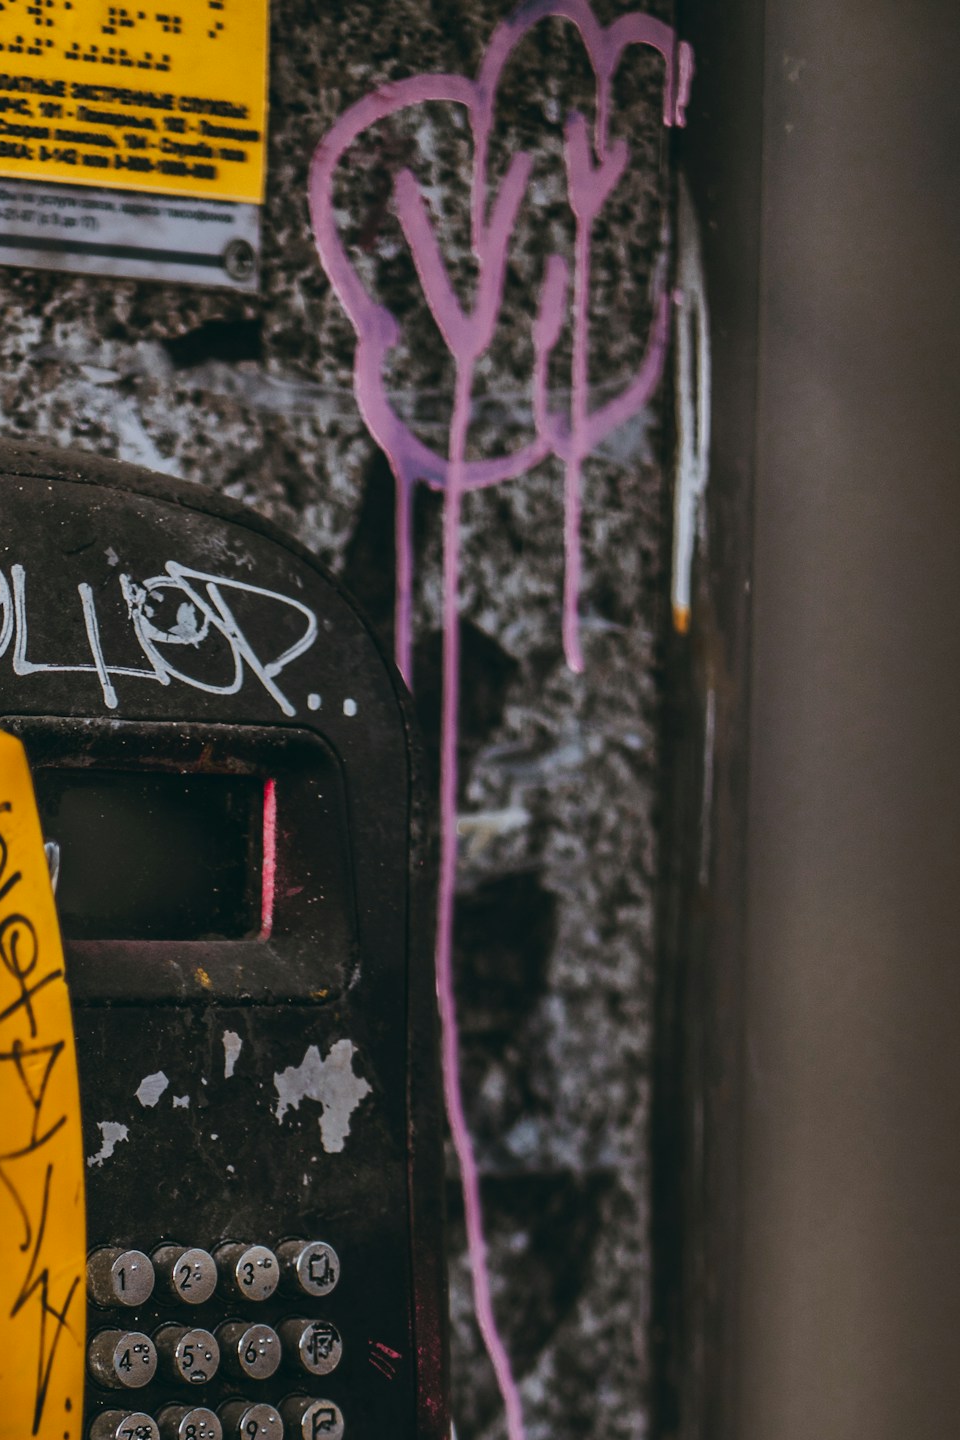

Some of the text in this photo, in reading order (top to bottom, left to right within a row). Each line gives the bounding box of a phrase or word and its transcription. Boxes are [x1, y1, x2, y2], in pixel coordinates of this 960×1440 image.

[117, 1261, 255, 1291] 1 2 3
[118, 1340, 257, 1372] 4 5 6
